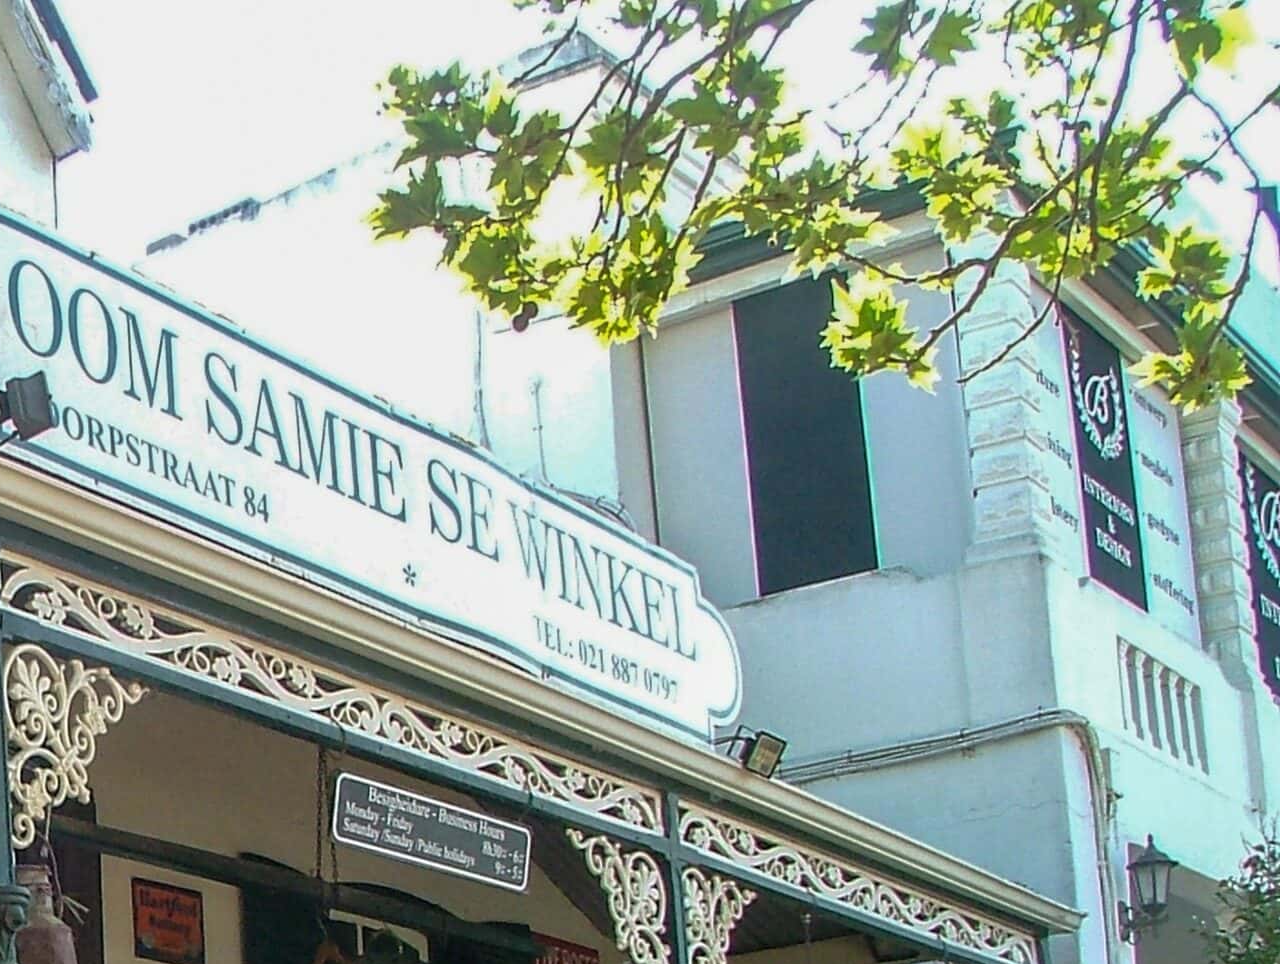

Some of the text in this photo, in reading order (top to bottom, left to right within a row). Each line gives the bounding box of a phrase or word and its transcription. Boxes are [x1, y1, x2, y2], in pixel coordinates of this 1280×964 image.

[8, 260, 696, 661] OOM SAMIE SE WINKEL
[244, 486, 269, 523] 84
[533, 615, 573, 659] TEL:
[578, 639, 605, 674] 021
[611, 653, 638, 687] 887
[343, 817, 380, 843] Saturday
[345, 800, 380, 824] Monday
[387, 812, 414, 834] Friday
[438, 807, 478, 834] Business
[479, 820, 505, 842] Hours
